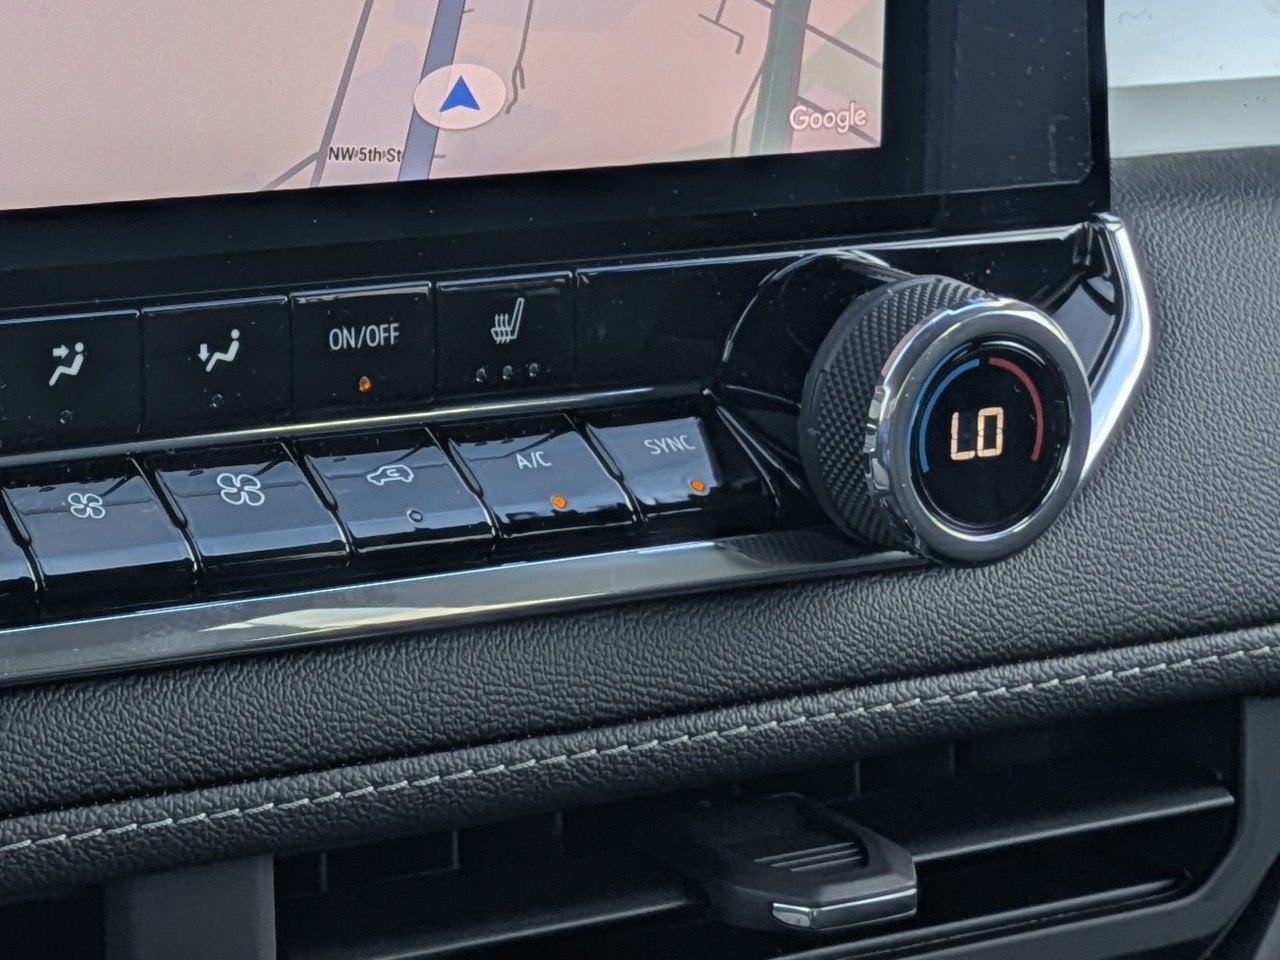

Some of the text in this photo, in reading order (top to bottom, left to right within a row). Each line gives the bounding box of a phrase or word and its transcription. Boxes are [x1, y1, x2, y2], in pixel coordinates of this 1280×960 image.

[789, 102, 868, 134] Google
[328, 146, 402, 162] NW 5th St
[329, 323, 400, 351] ON/OFF
[644, 434, 696, 456] SYNC
[516, 450, 552, 470] A/C
